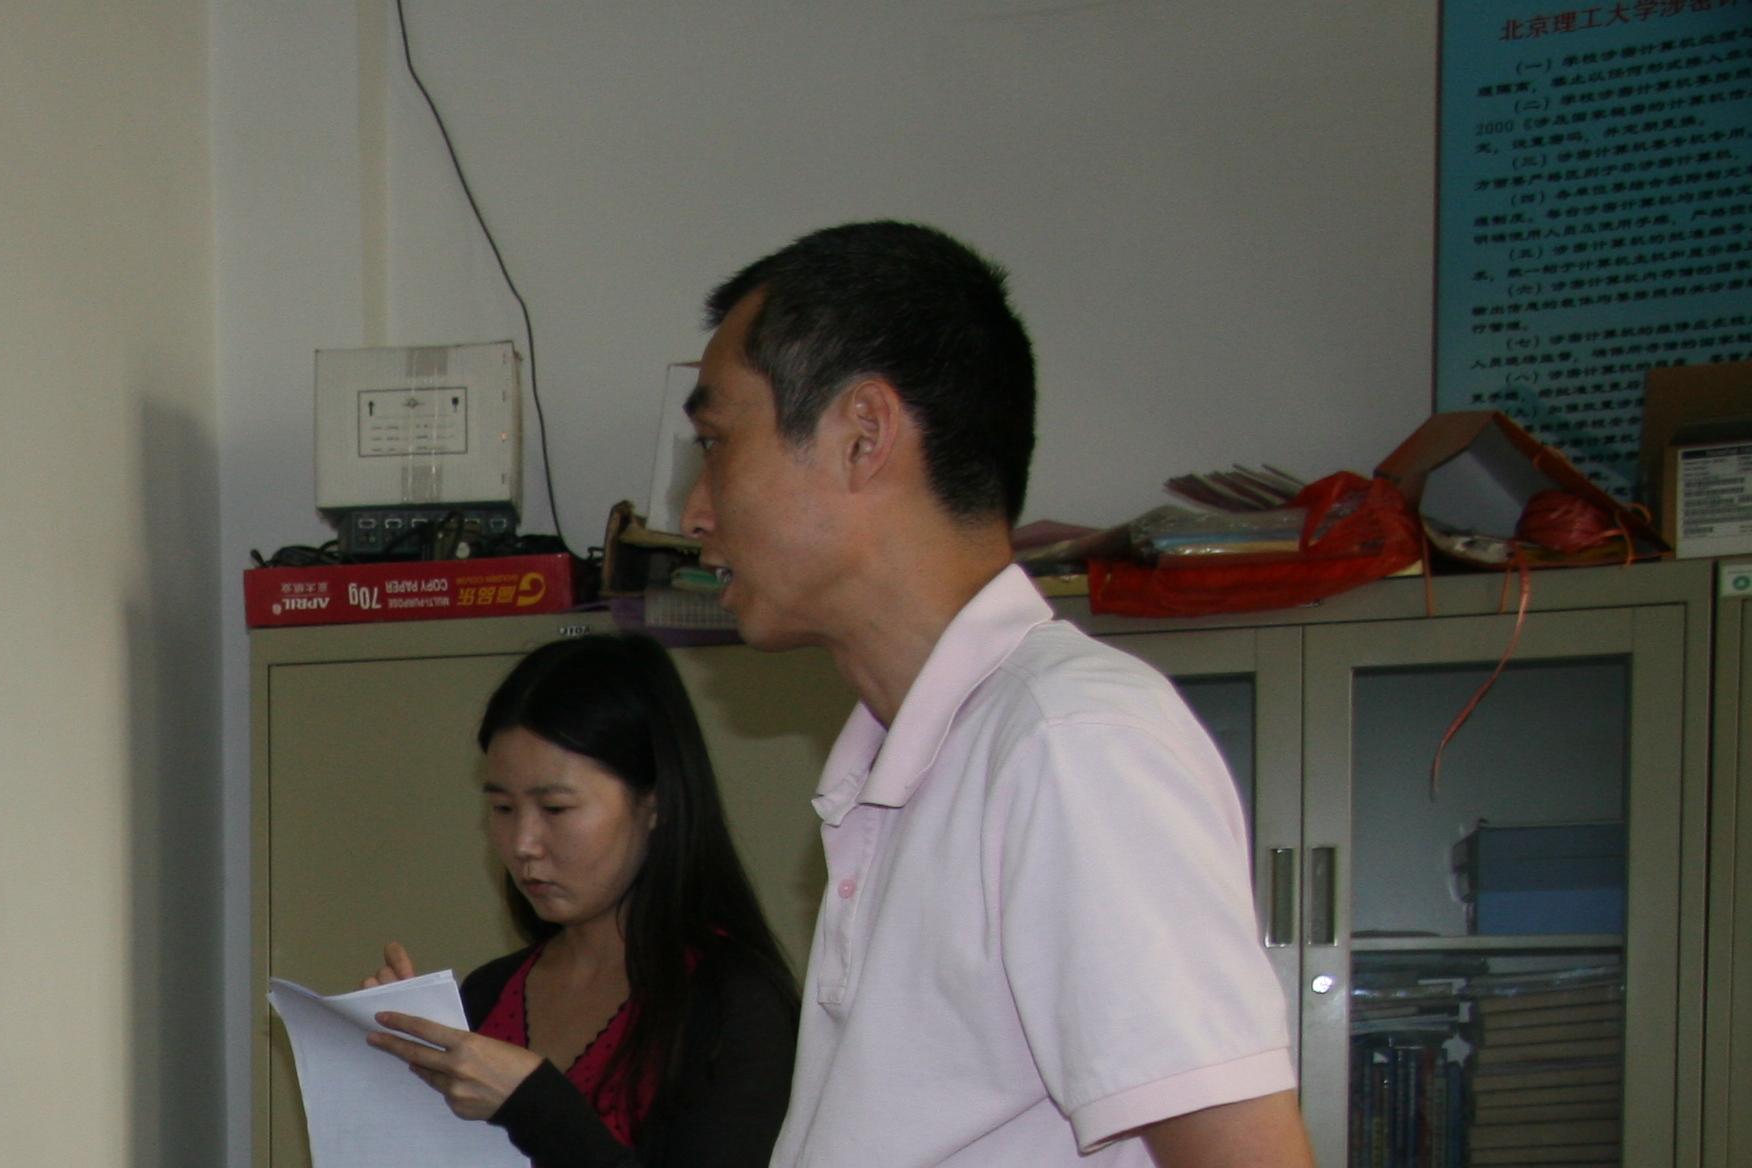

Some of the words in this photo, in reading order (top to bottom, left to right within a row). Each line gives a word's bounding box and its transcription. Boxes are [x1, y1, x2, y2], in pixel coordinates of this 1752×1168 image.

[385, 579, 418, 594] PAPER
[420, 578, 448, 593] COPY
[349, 581, 382, 608] 70g
